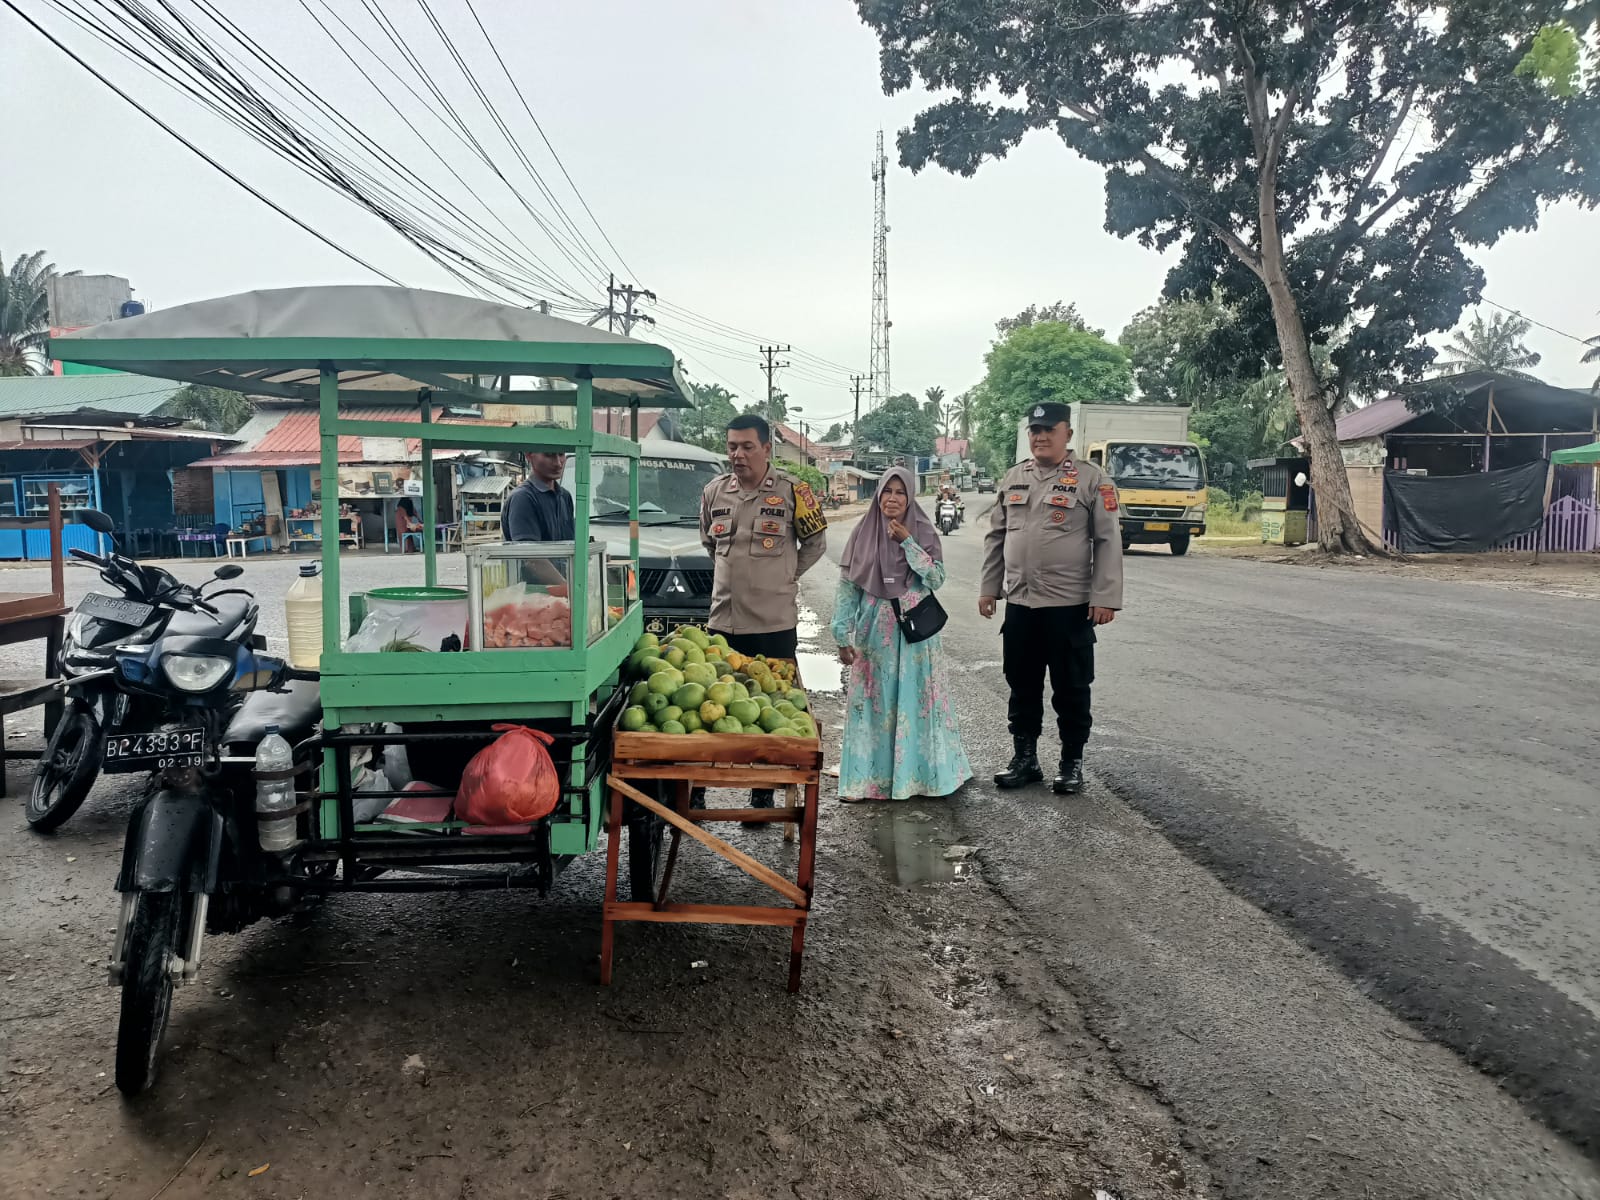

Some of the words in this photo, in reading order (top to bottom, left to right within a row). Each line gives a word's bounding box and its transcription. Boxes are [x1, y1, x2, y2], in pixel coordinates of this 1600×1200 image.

[667, 461, 696, 471] BARAT
[1052, 484, 1077, 494] POLRI
[760, 507, 785, 517] POLRI
[85, 594, 99, 607] BL
[132, 733, 180, 754] 4393
[190, 732, 202, 750] F
[158, 758, 174, 768] 02
